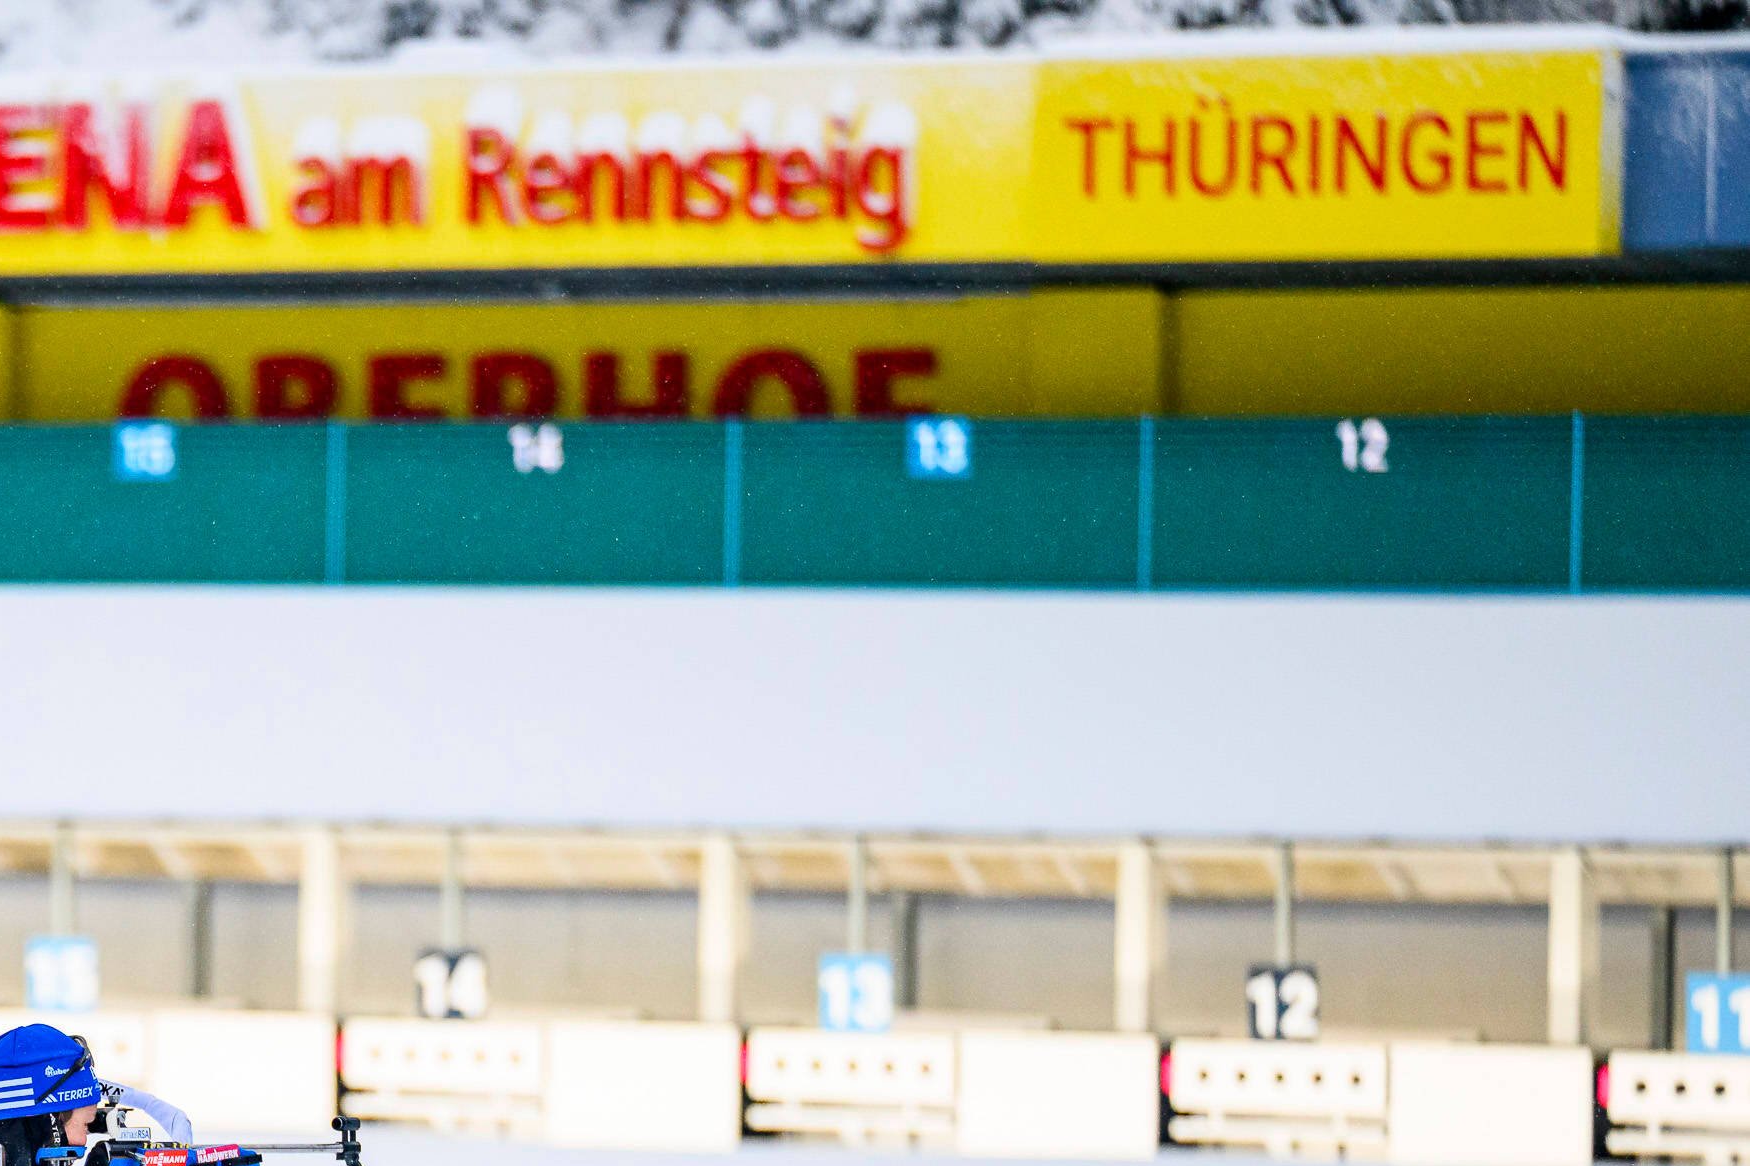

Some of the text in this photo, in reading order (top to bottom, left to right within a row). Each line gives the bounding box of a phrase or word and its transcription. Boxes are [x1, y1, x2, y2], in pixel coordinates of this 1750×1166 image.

[1064, 96, 1572, 200] THÜRINGEN
[291, 146, 426, 228] am
[466, 118, 910, 255] Rennsteig
[915, 420, 969, 474] 13
[1336, 418, 1389, 472] 12
[820, 959, 892, 1032] 13
[1246, 970, 1319, 1040] 12
[1691, 984, 1750, 1049] 11
[57, 1086, 94, 1102] TERREX
[197, 1149, 239, 1164] HANDWERK
